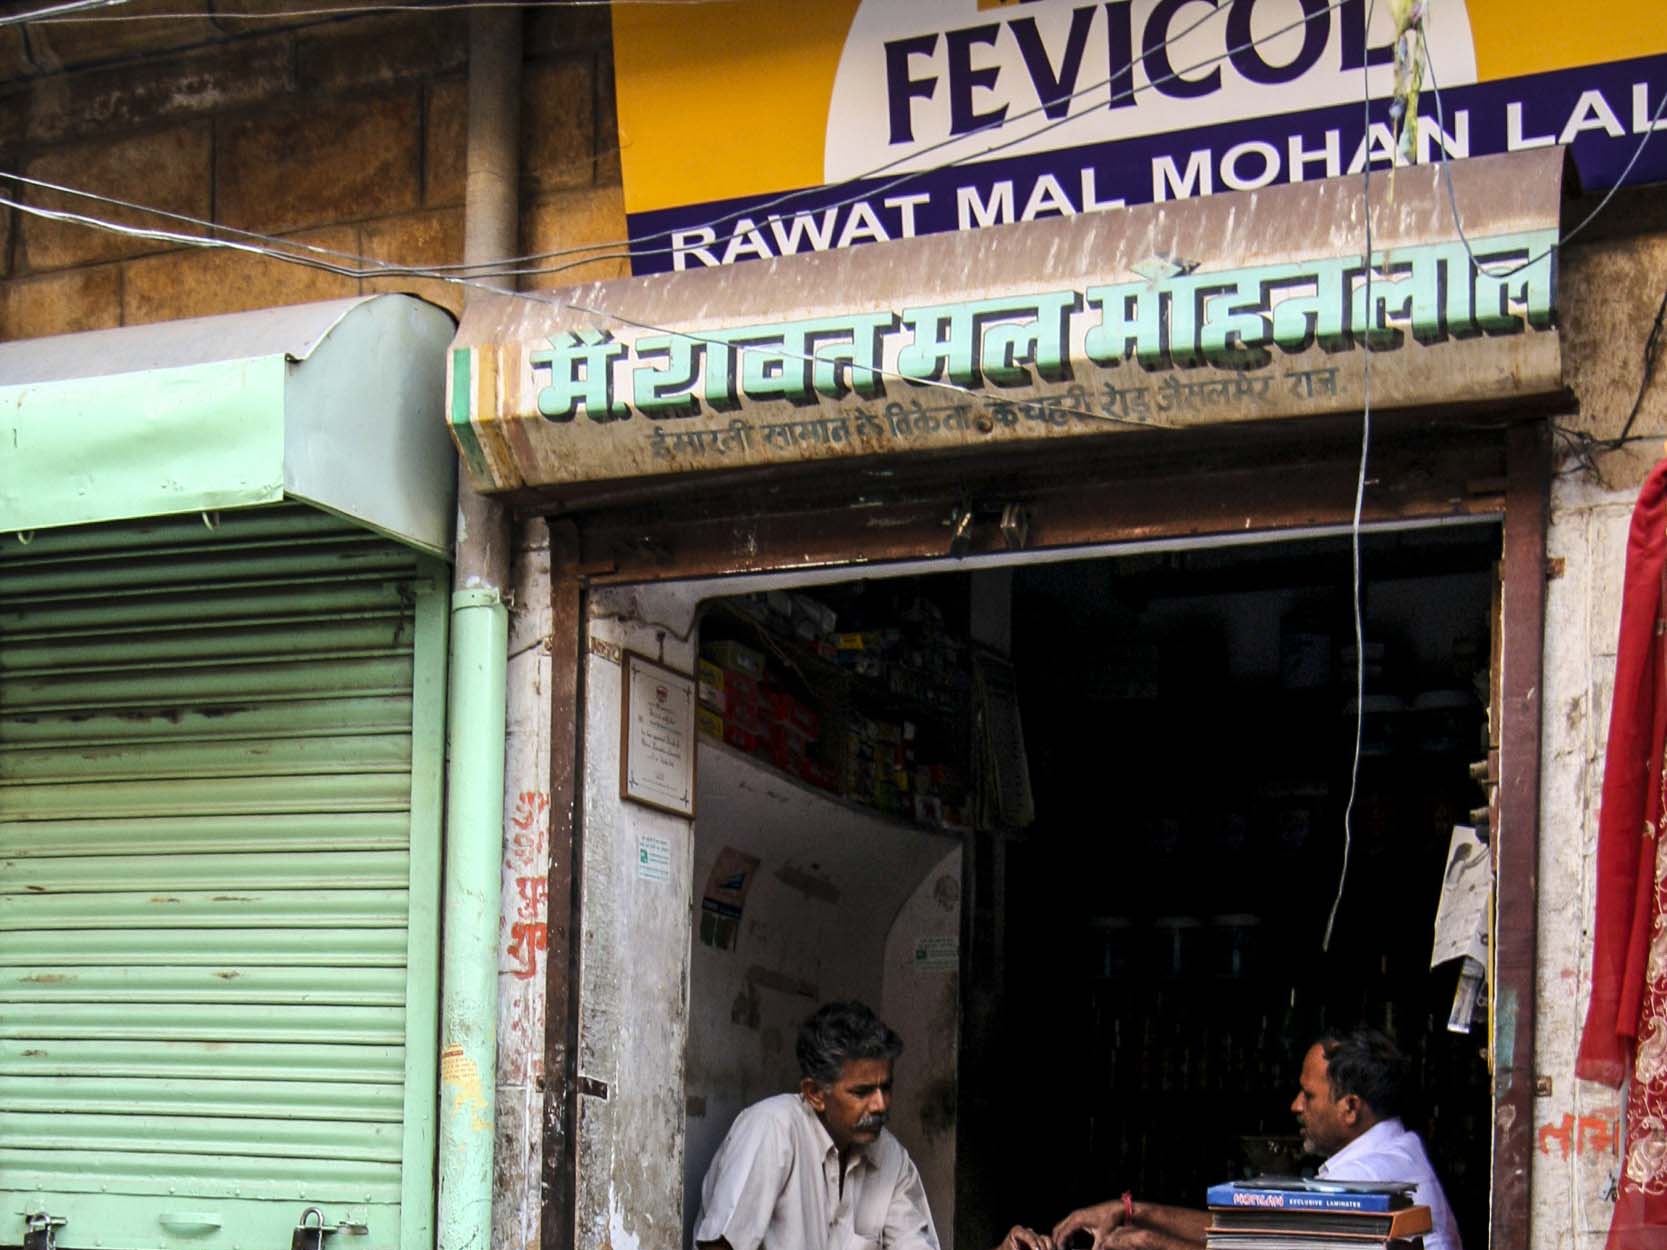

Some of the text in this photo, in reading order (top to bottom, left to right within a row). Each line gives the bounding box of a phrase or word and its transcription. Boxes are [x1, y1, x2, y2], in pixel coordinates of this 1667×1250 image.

[884, 0, 1399, 145] FEVICOL
[671, 82, 1667, 271] RAWAT MAL MOHAN LAL
